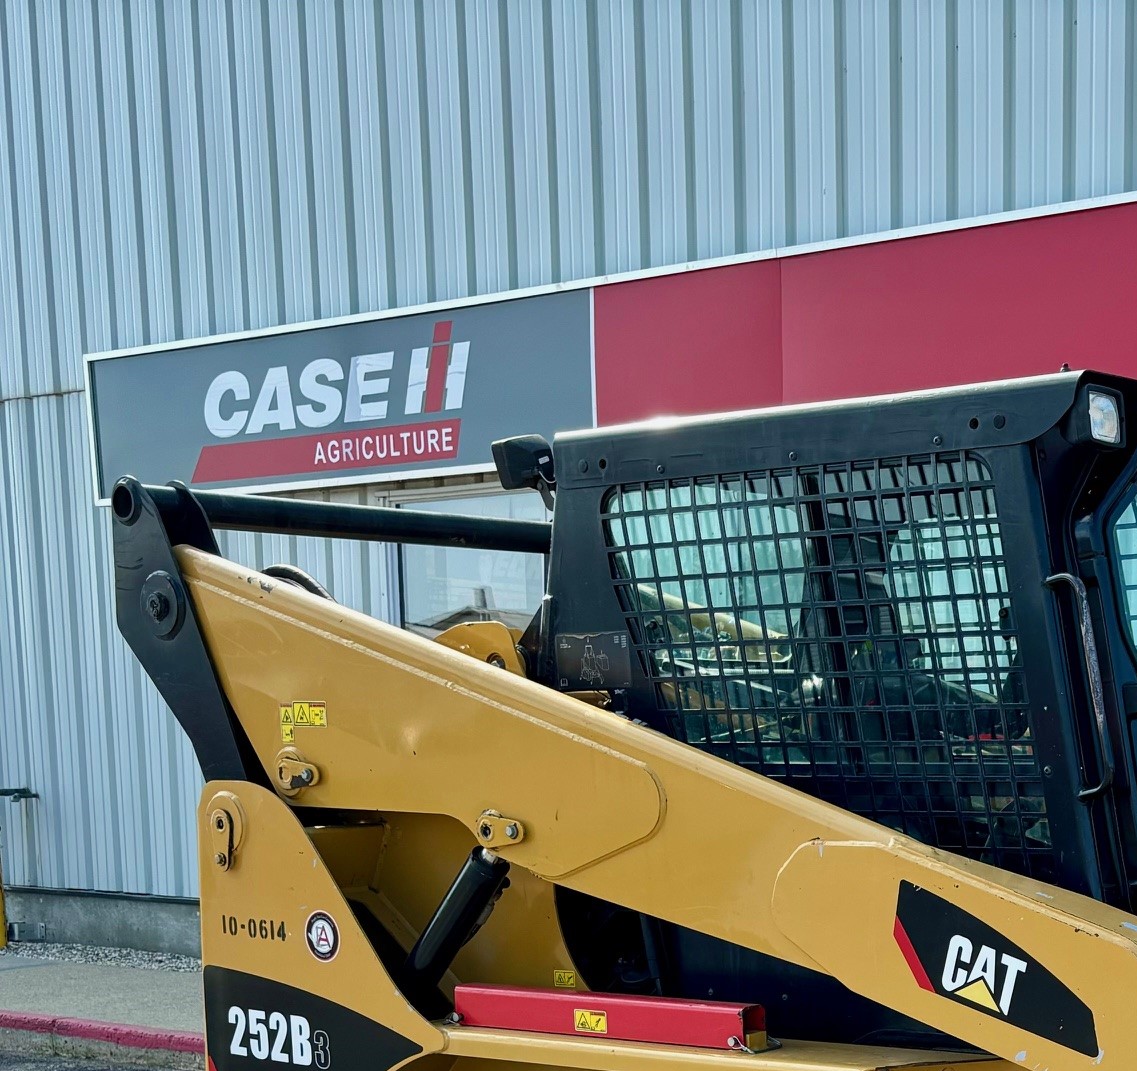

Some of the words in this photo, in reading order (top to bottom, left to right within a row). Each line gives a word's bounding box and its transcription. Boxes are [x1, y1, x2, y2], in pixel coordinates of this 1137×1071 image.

[204, 351, 394, 438] CASE
[314, 427, 454, 465] AGRICULTURE
[942, 934, 1028, 1016] CAT
